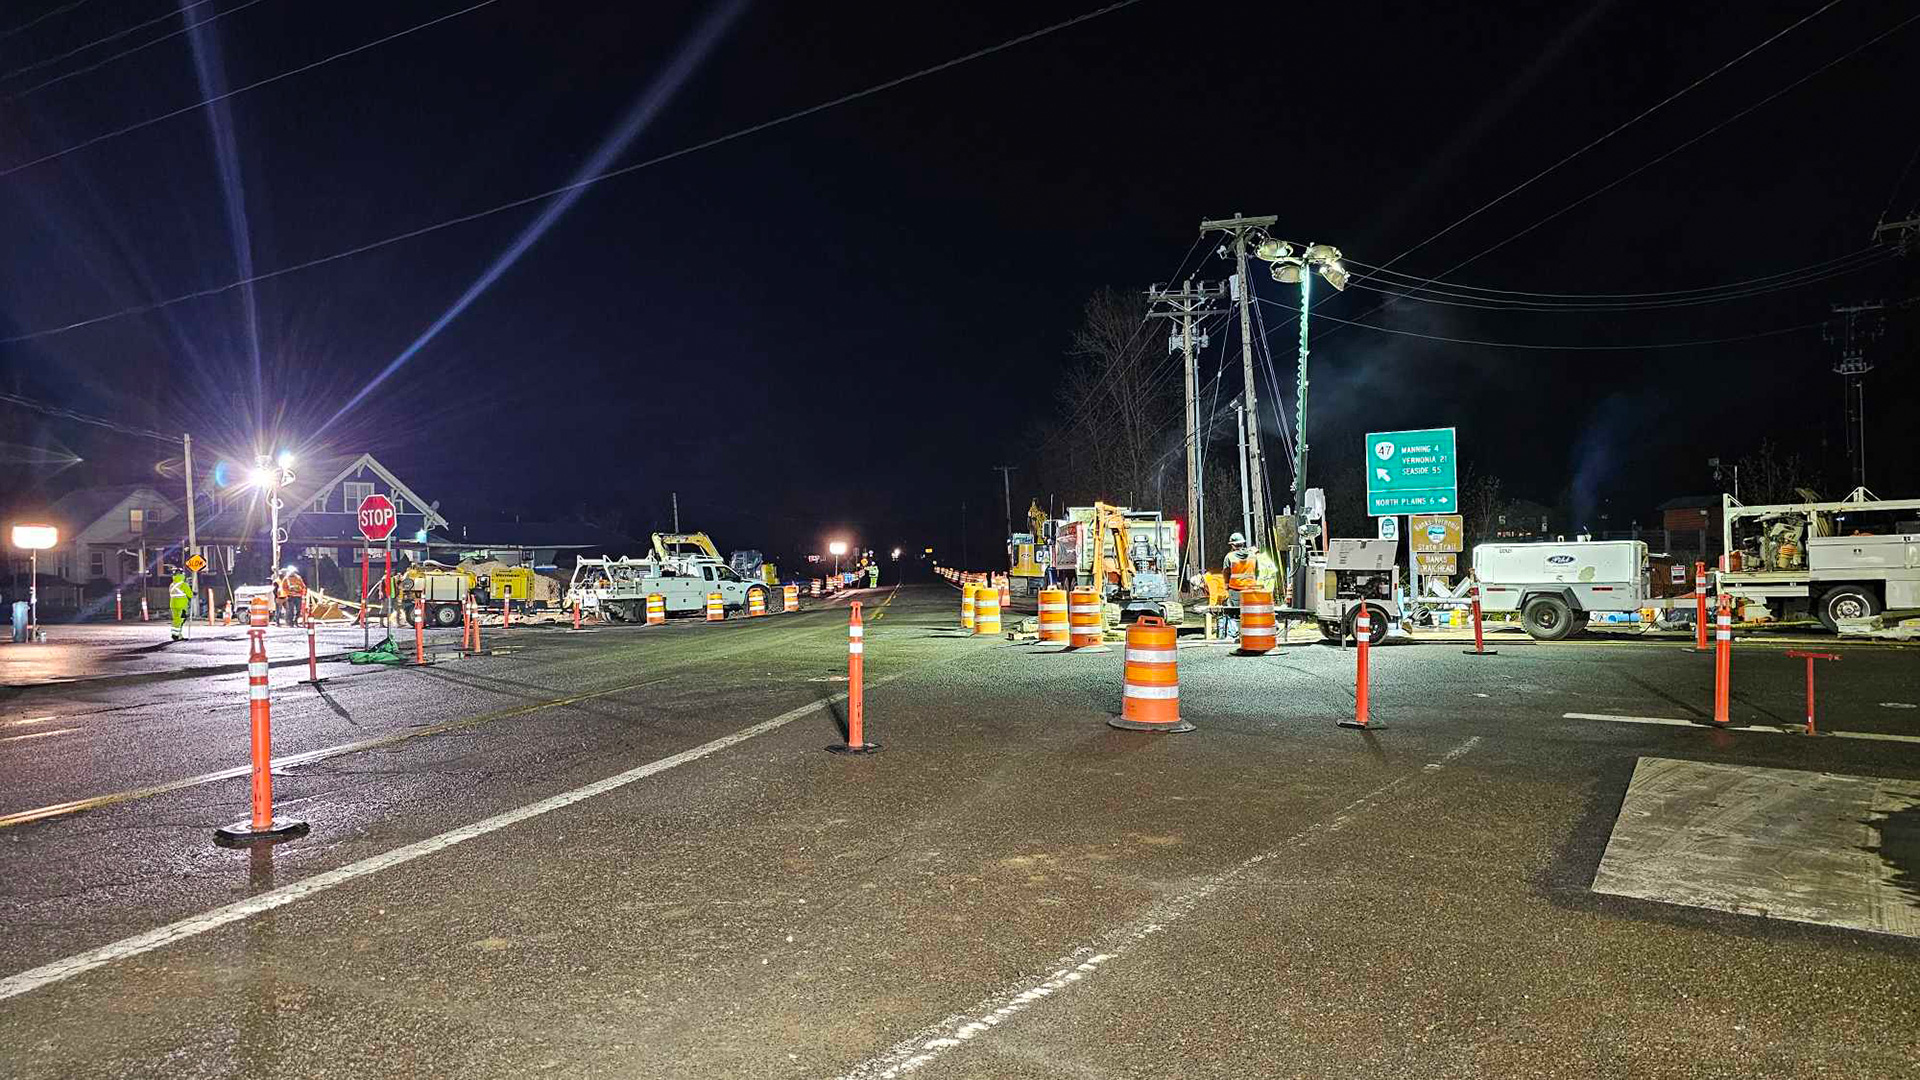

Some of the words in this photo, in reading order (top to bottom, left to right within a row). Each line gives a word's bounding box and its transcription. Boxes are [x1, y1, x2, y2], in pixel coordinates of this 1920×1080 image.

[1378, 445, 1391, 455] 47
[1401, 446, 1431, 454] MANNING
[1402, 467, 1429, 475] SEASIDE
[1432, 466, 1441, 474] 55
[361, 509, 393, 526] STOP
[1036, 551, 1050, 563] CA
[1425, 555, 1448, 563] BANKS
